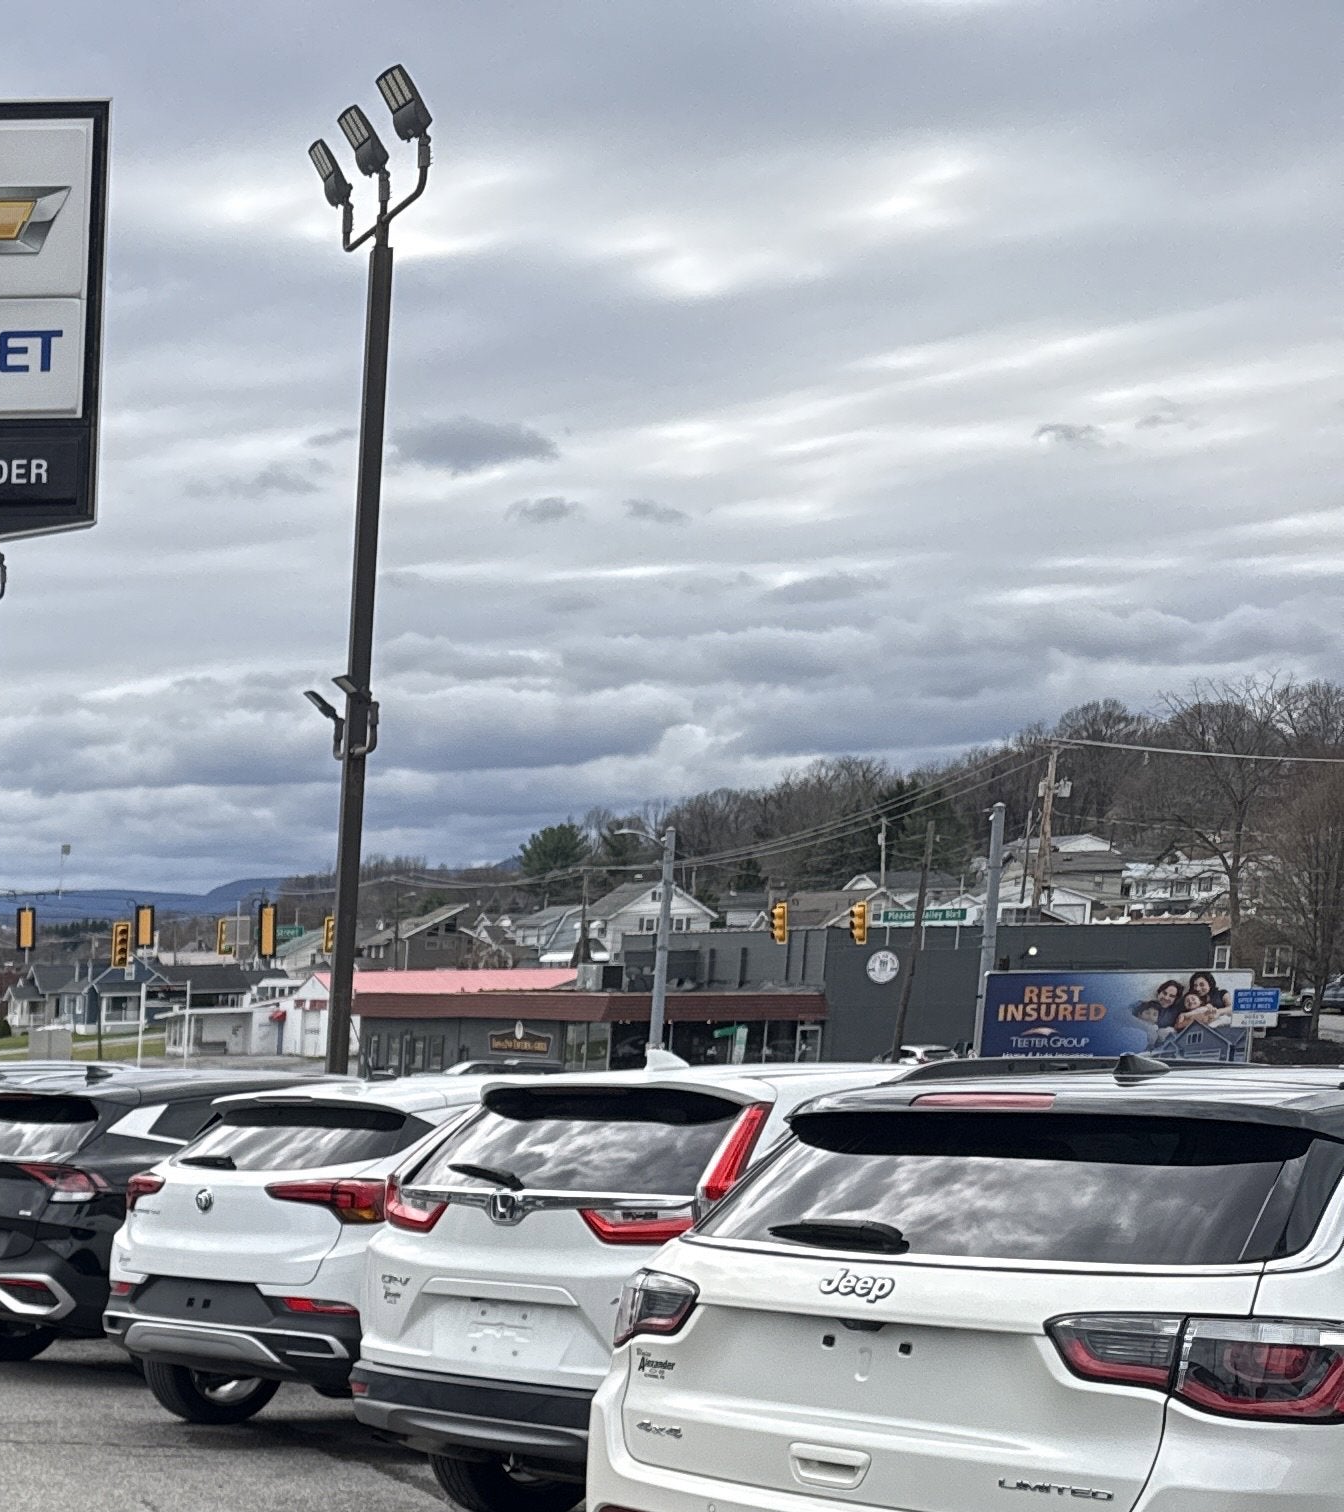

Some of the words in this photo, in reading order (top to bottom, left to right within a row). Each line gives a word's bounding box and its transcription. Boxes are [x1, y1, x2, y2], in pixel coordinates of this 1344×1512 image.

[923, 910, 943, 921] alley
[1024, 985, 1085, 1003] REST
[997, 1004, 1108, 1021] INSURED
[1010, 1036, 1049, 1048] TEETER
[1049, 1036, 1090, 1048] GROUP
[819, 1267, 896, 1304] Jeep
[637, 1356, 676, 1373] Alexander
[635, 1420, 683, 1439] 4x4
[998, 1478, 1115, 1501] LIMITED
